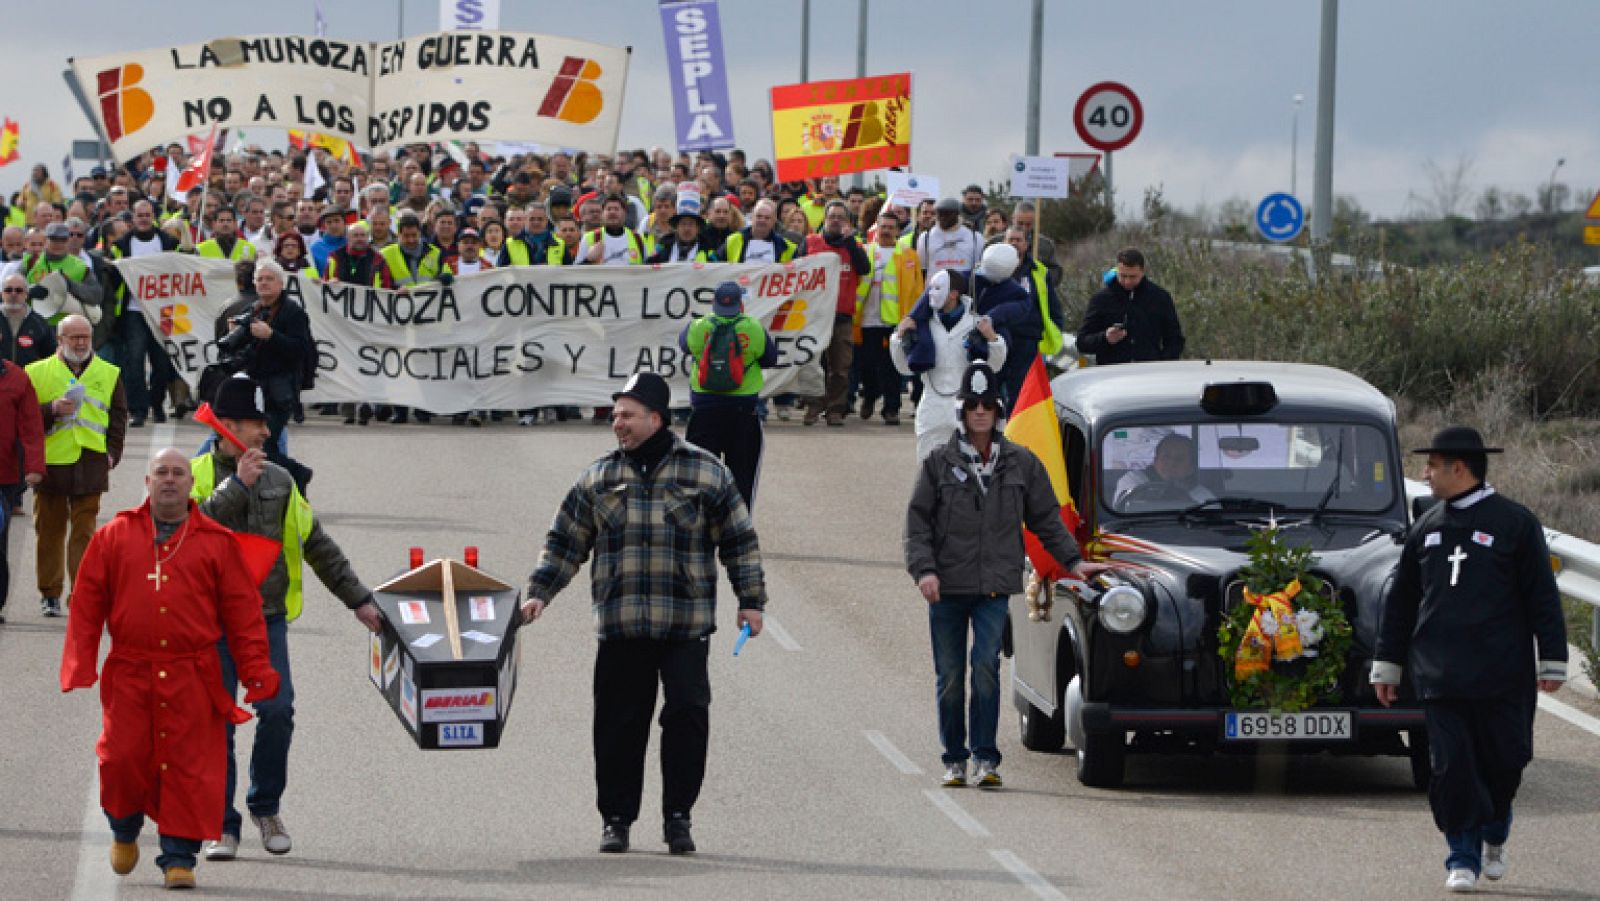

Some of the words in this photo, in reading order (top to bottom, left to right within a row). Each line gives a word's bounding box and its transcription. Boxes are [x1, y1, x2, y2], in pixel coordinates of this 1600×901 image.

[454, 0, 485, 29] S
[171, 47, 222, 70] LA
[240, 35, 368, 76] MUÑOZA
[379, 41, 406, 77] EN
[418, 34, 540, 70] GUERRA
[674, 8, 724, 141] SEPLA
[183, 97, 232, 128] NO
[253, 94, 277, 121] A
[295, 95, 356, 134] LOS
[368, 100, 492, 148] DESPIDOS
[1087, 104, 1130, 128] 40
[137, 272, 207, 300] IBERIA
[286, 275, 307, 311] A
[481, 283, 621, 318] CONTRA
[641, 286, 715, 320] LOS
[758, 266, 827, 299] IBERIA
[357, 341, 545, 381] SOCIALES
[564, 343, 586, 374] Y
[1241, 714, 1297, 736] 6958
[1303, 715, 1346, 736] DDX
